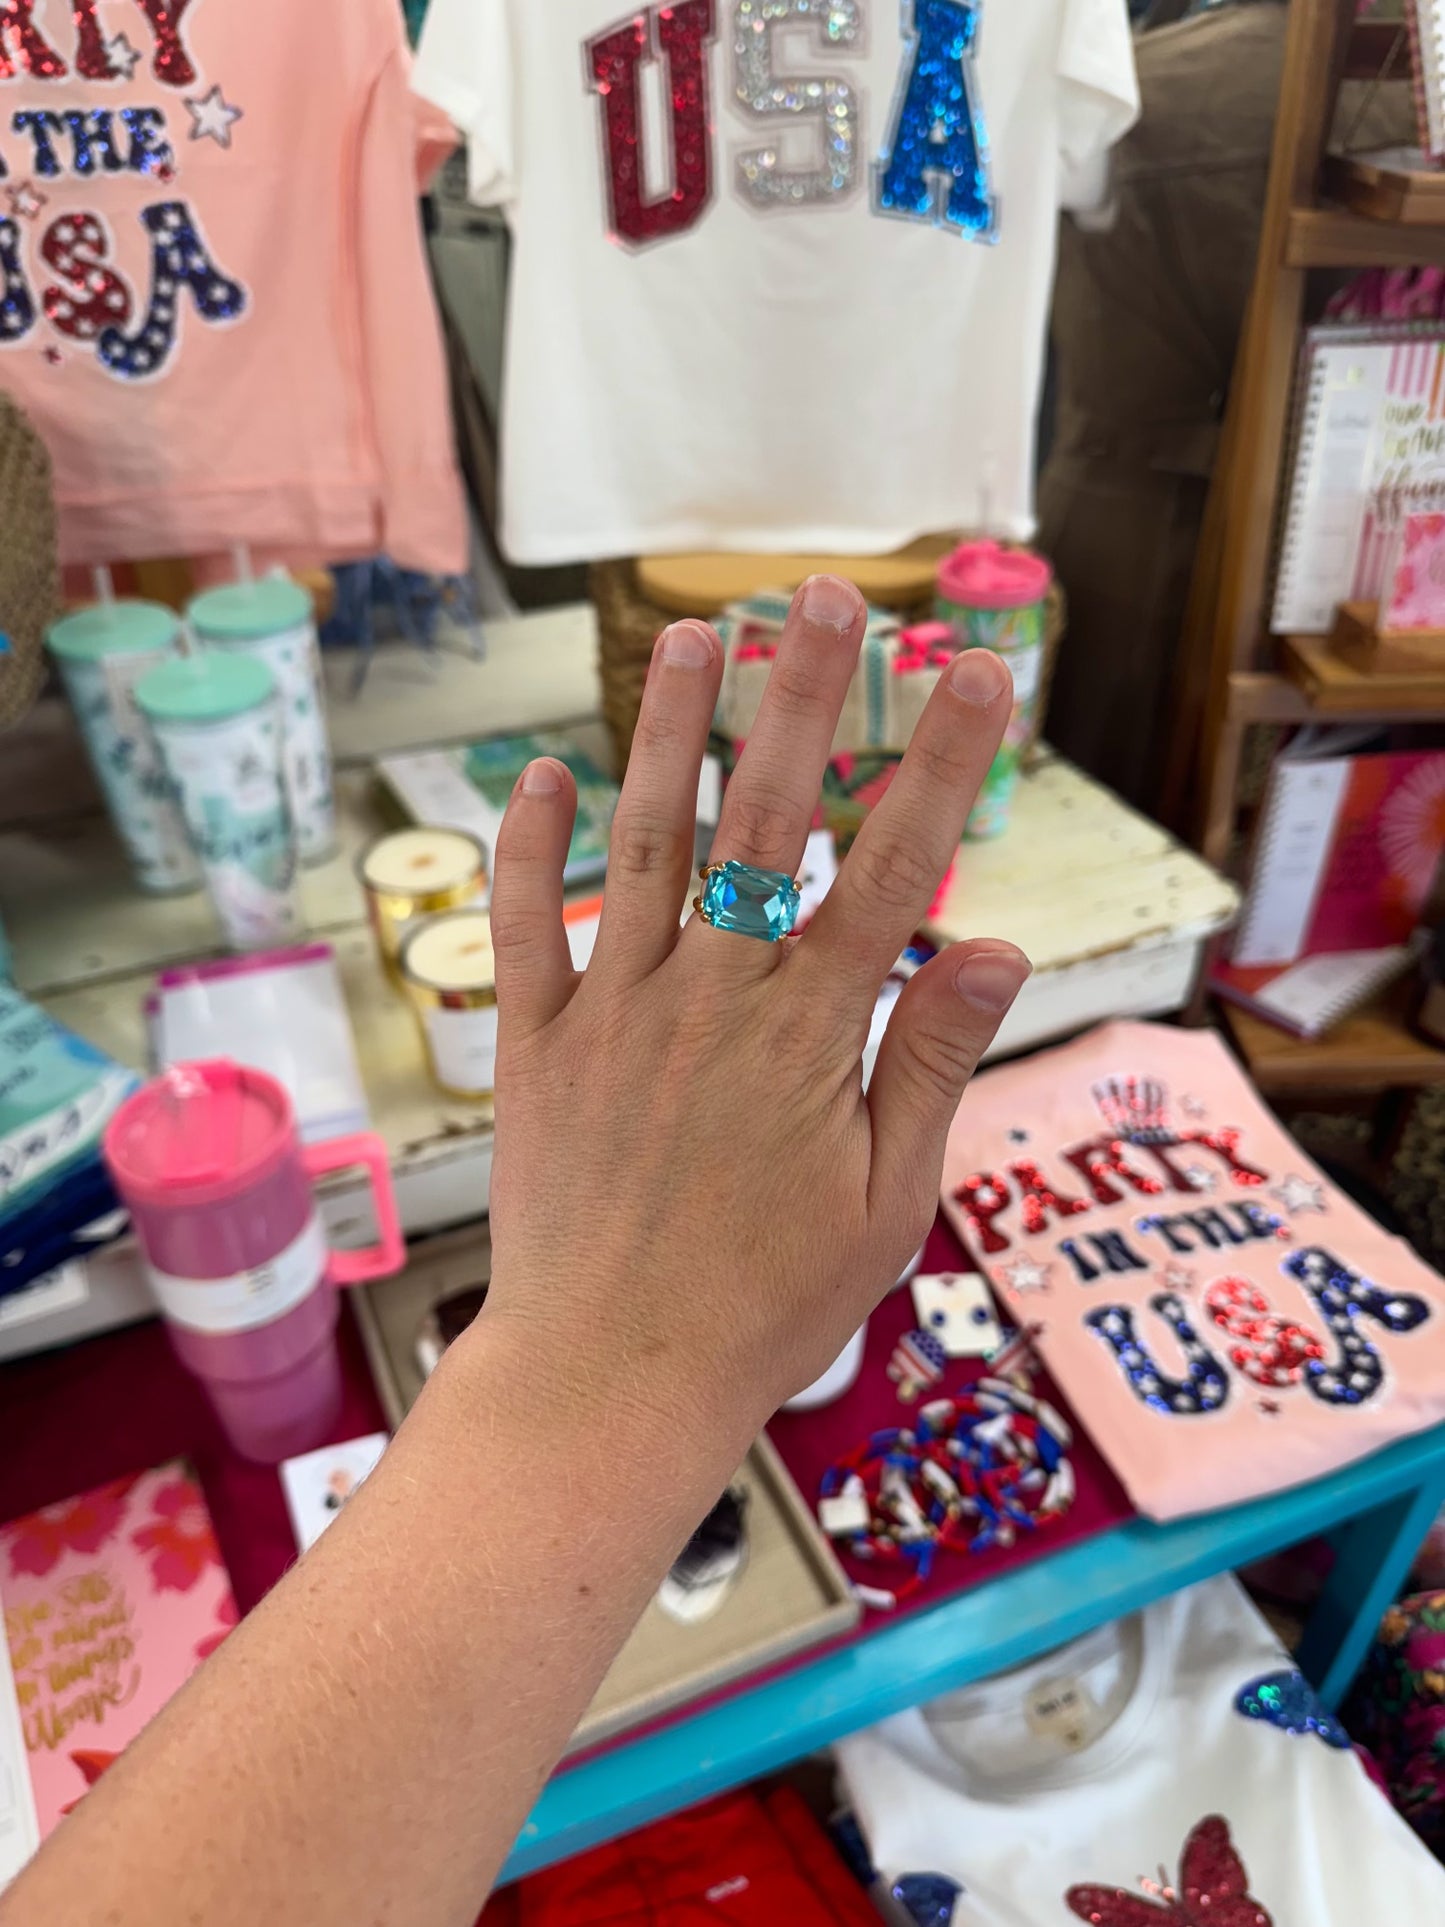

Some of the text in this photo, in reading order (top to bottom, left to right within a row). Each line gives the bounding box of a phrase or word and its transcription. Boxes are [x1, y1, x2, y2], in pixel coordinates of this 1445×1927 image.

[11, 107, 171, 176] THE
[581, 0, 1000, 256] USA
[952, 1126, 1270, 1255] PARTY
[1057, 1202, 1285, 1283] IN THE
[1083, 1246, 1432, 1416] USA
